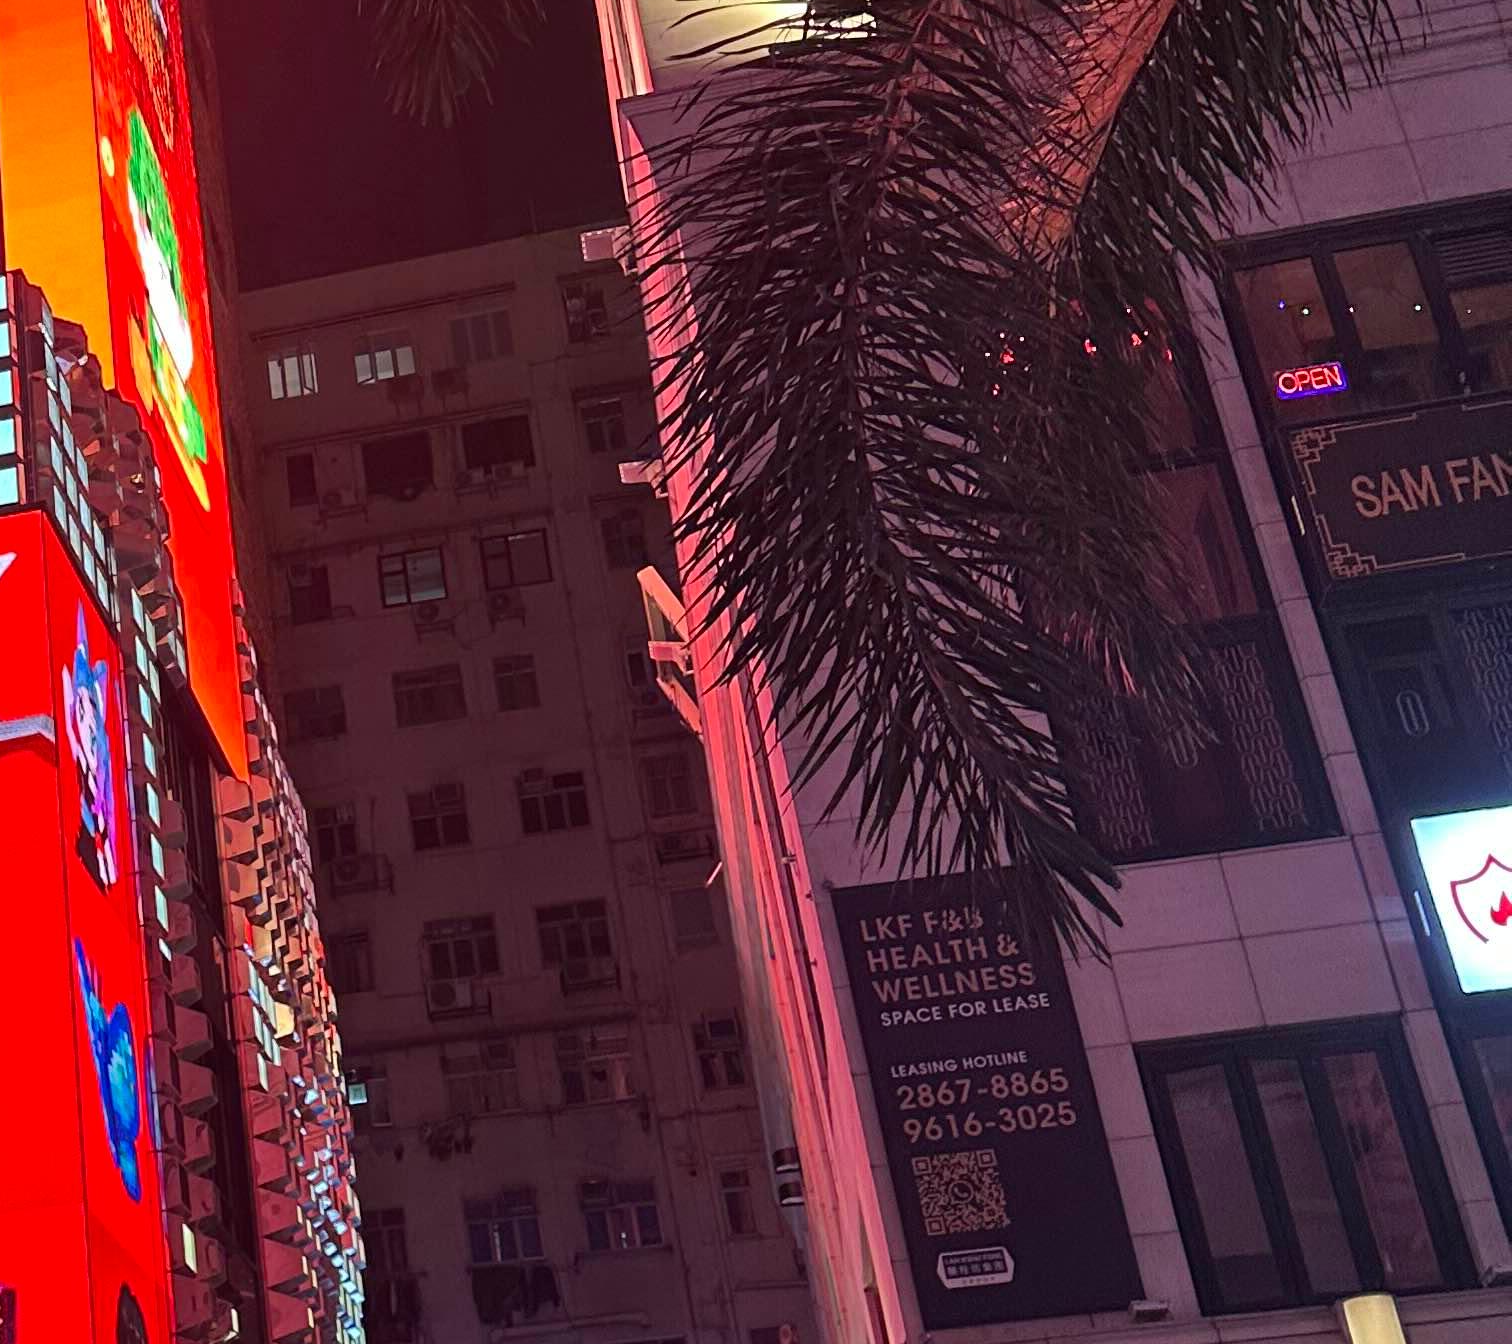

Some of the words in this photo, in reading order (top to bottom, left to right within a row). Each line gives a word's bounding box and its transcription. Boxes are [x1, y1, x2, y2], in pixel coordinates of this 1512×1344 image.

[1278, 364, 1342, 394] OPEN
[1352, 465, 1442, 518] SAM
[860, 914, 912, 942] LKF
[866, 937, 988, 972] HEALTH
[997, 933, 1019, 956] &
[872, 962, 1036, 1003] WELLNESS
[880, 1006, 942, 1026] SPACE
[948, 1001, 986, 1019] FOR
[993, 993, 1050, 1013] LEASE
[891, 1059, 957, 1078] LEASING
[962, 1051, 1028, 1070] HOTLINE
[897, 1067, 1069, 1110] 2867-8865
[903, 1101, 1077, 1143] 9616-3025
